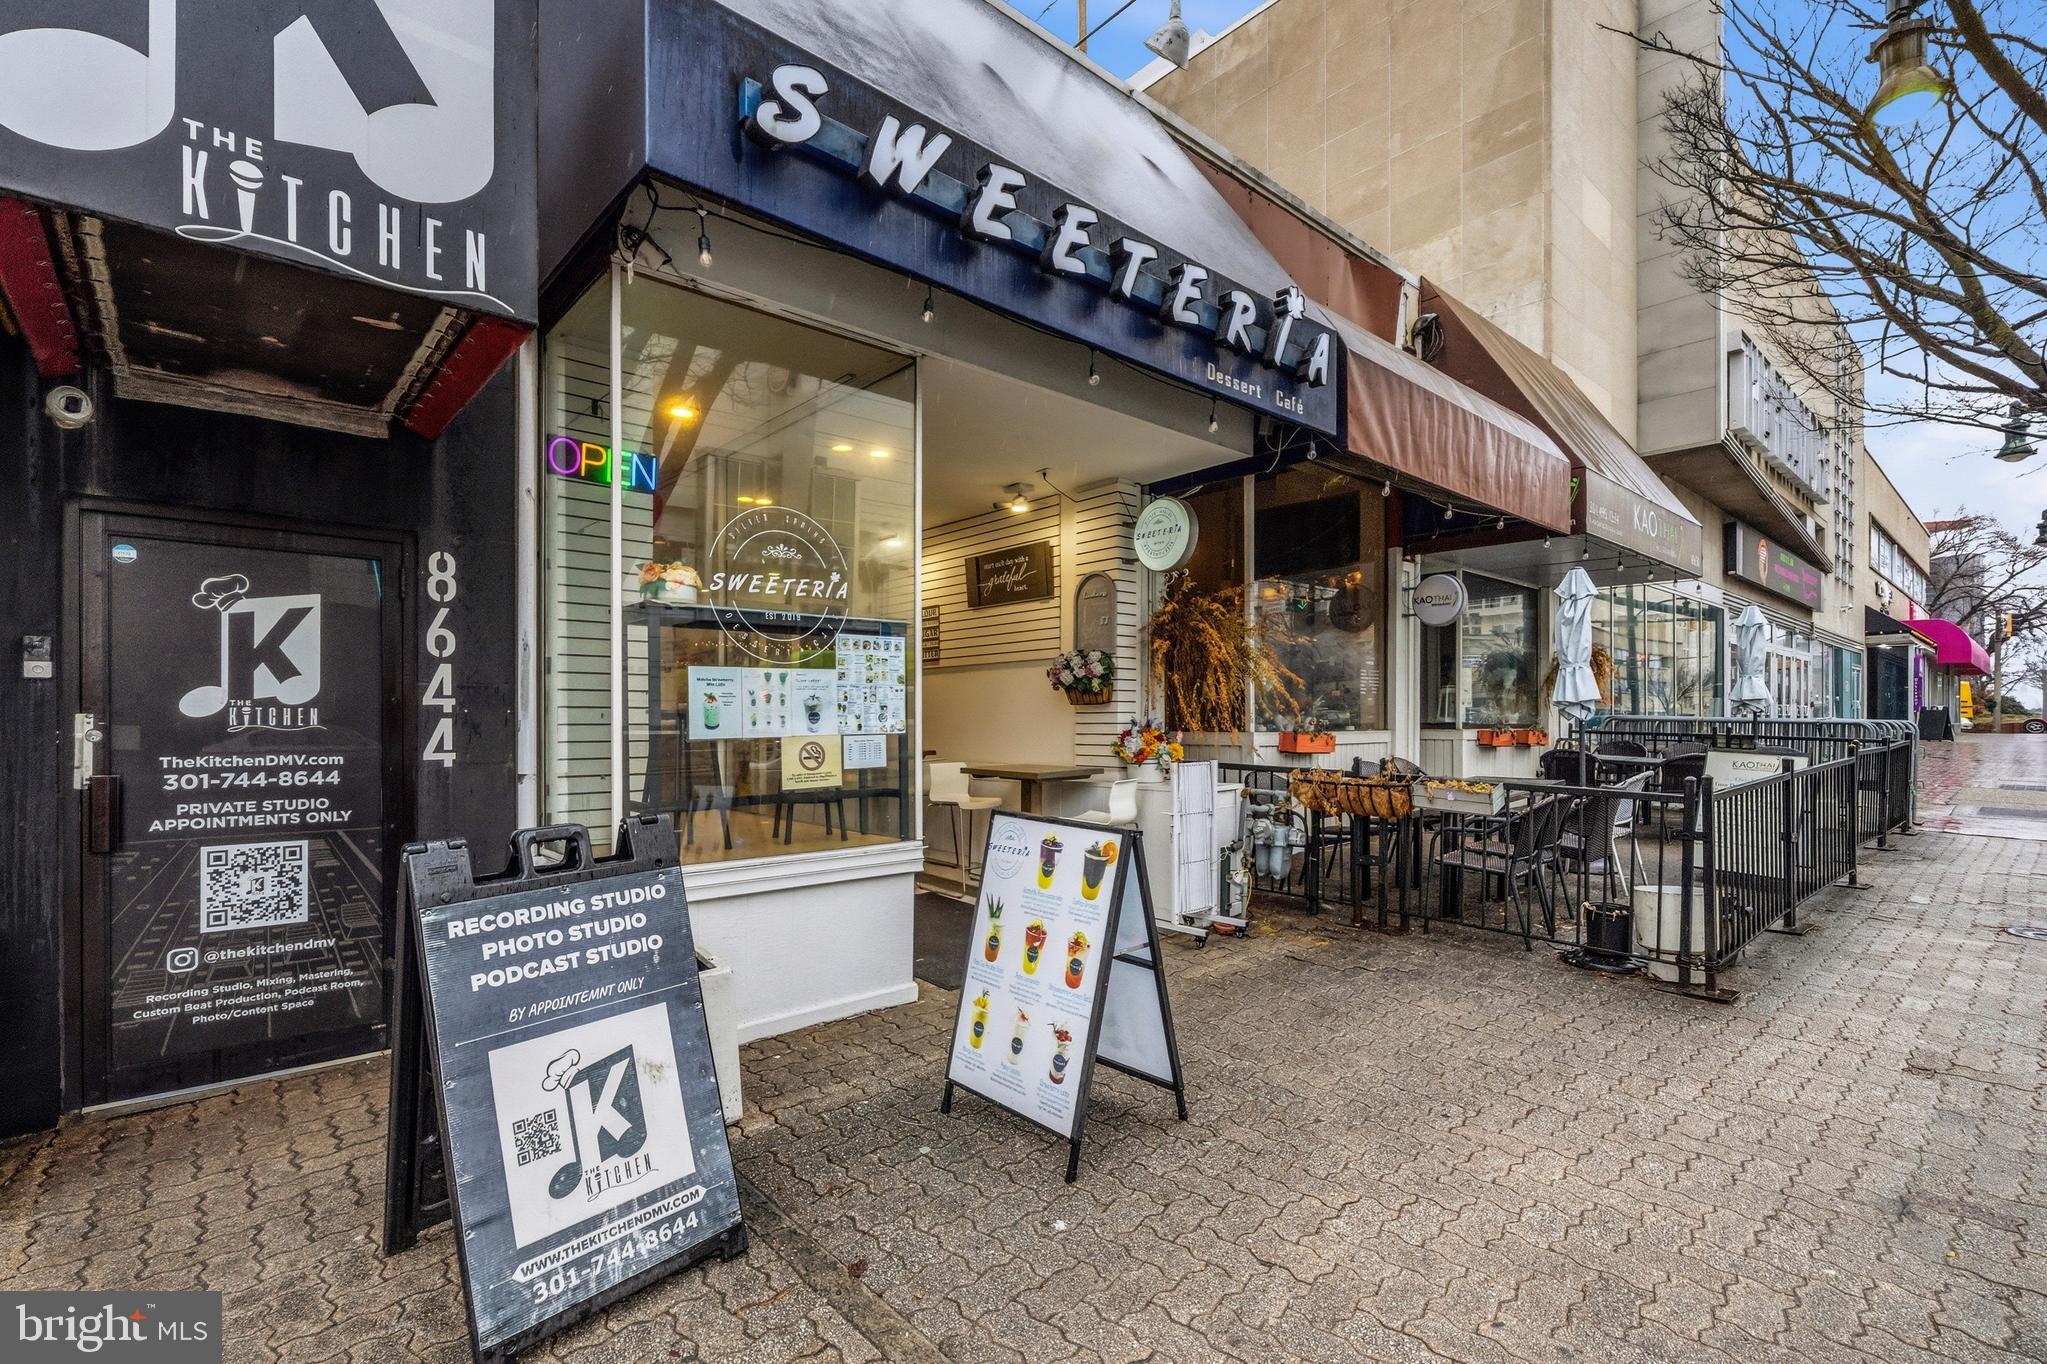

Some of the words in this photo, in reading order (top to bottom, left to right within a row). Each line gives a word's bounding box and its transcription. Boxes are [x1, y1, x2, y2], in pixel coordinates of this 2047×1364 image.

[183, 118, 263, 161] THE
[183, 145, 486, 293] KITCHEN
[756, 63, 1331, 386] SWEETERIA
[1207, 362, 1262, 399] Dessert
[548, 437, 657, 491] OPEN
[709, 571, 848, 600] SWEETERIA
[422, 551, 457, 768] 8644
[229, 707, 318, 726] KITCHEN
[159, 754, 344, 769] TheKitchenDMV.com
[163, 770, 341, 791] 301-744-8644
[148, 813, 301, 832] APPOINTMENTS
[306, 810, 352, 823] ONLY
[177, 801, 257, 816] PRIVATE
[262, 798, 329, 812] STUDIO
[447, 899, 587, 939] RECORDING
[590, 884, 667, 911] STUDIO
[203, 938, 336, 963] @thekitchendmv
[482, 929, 564, 961] PHOTO
[569, 912, 647, 942] STUDIO
[470, 952, 581, 992] PODCAST
[586, 934, 664, 965] STUDIO
[133, 1006, 181, 1019] Custom
[185, 1001, 212, 1012] Beat
[215, 991, 282, 1007] Production,
[284, 984, 328, 997] Podcast
[330, 979, 364, 991] Room,
[146, 988, 209, 1004] Recording
[212, 982, 253, 995] Studio,
[256, 977, 296, 991] Mixing,
[299, 968, 354, 982] Mastering,
[508, 1006, 527, 1023] BY
[528, 983, 616, 1018] APPOINTEMNT
[617, 977, 645, 993] ONLY
[192, 1005, 278, 1024] Photo/Content
[281, 1000, 314, 1013] Space
[584, 1165, 600, 1176] THE
[585, 1153, 652, 1196] KITCHEN
[520, 1189, 700, 1277] WWW.THEKITCHENDMV.COM
[532, 1211, 699, 1304] 301-744-8644
